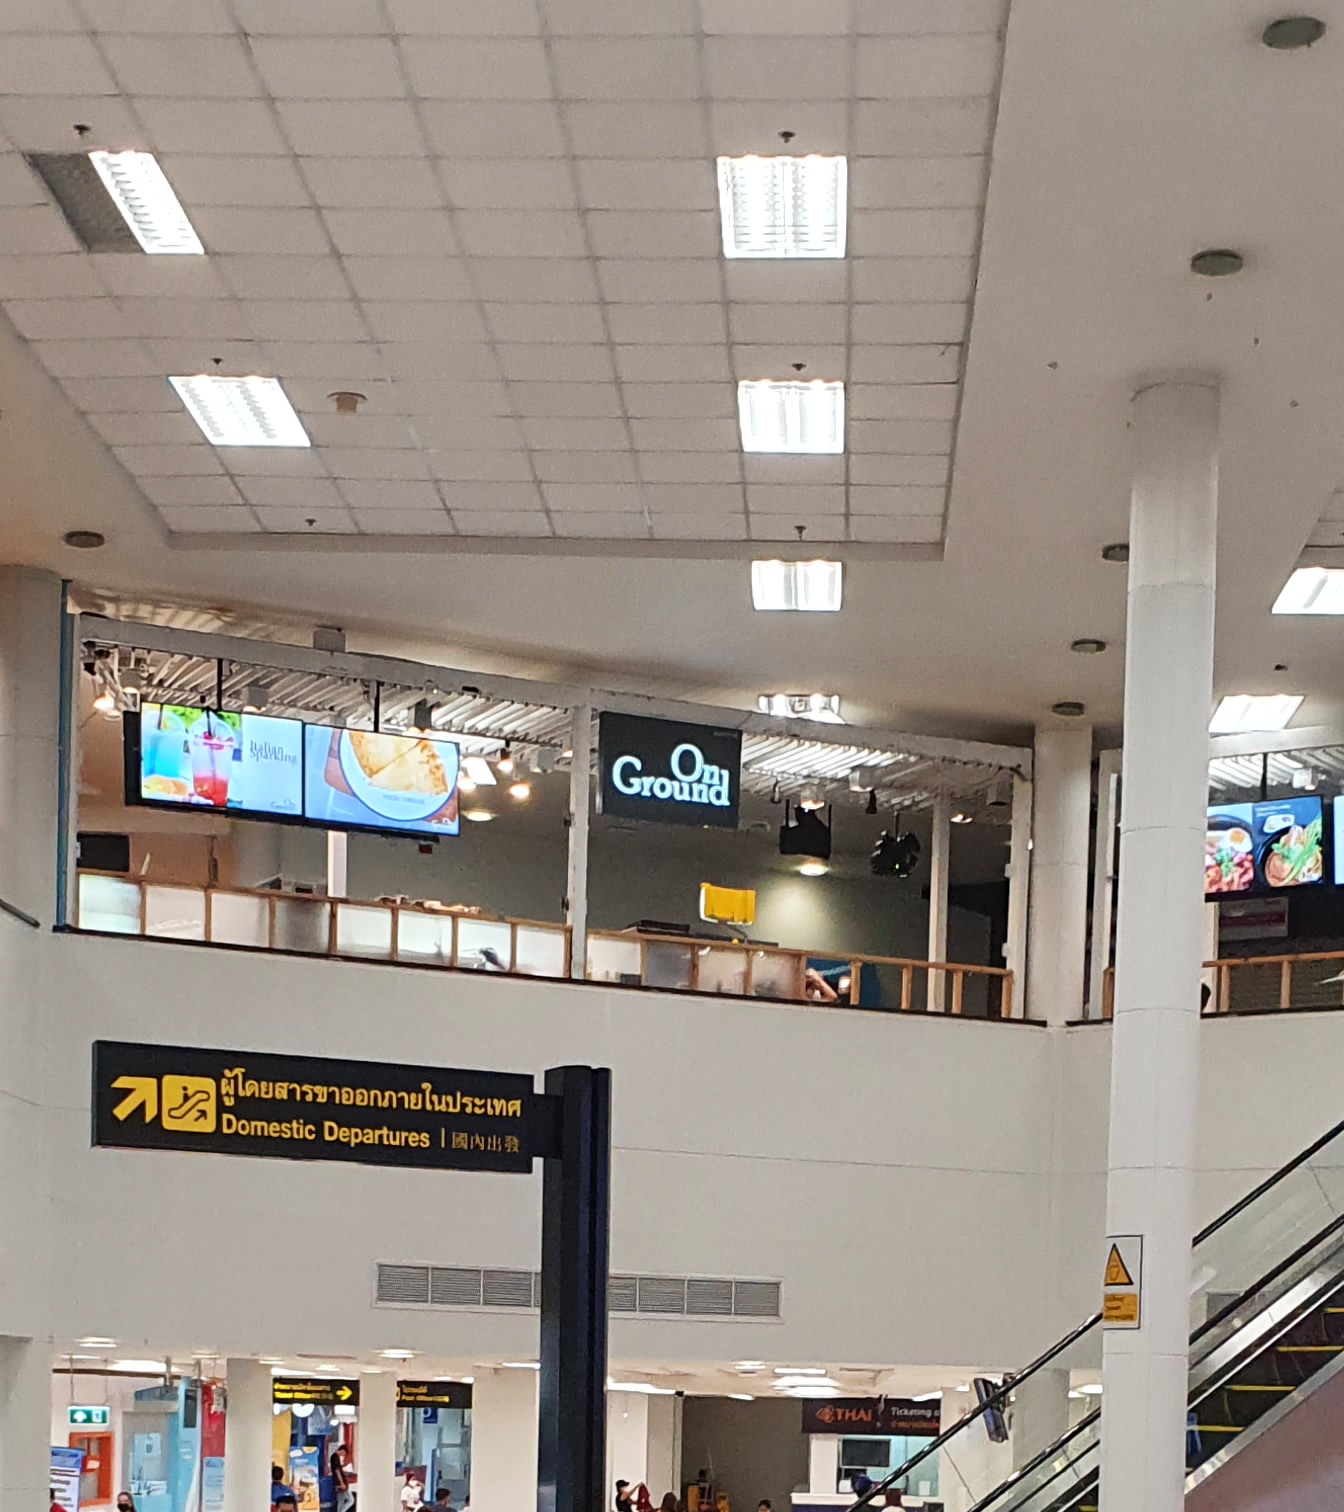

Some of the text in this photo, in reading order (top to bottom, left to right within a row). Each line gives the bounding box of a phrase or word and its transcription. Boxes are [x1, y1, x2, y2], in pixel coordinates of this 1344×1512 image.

[612, 755, 731, 807] Ground
[671, 743, 720, 785] On
[221, 1068, 522, 1118] ผู้โดยสารขาออกภายในประเทศ
[222, 1113, 431, 1149] Domestic Departures
[836, 1407, 873, 1422] THAI
